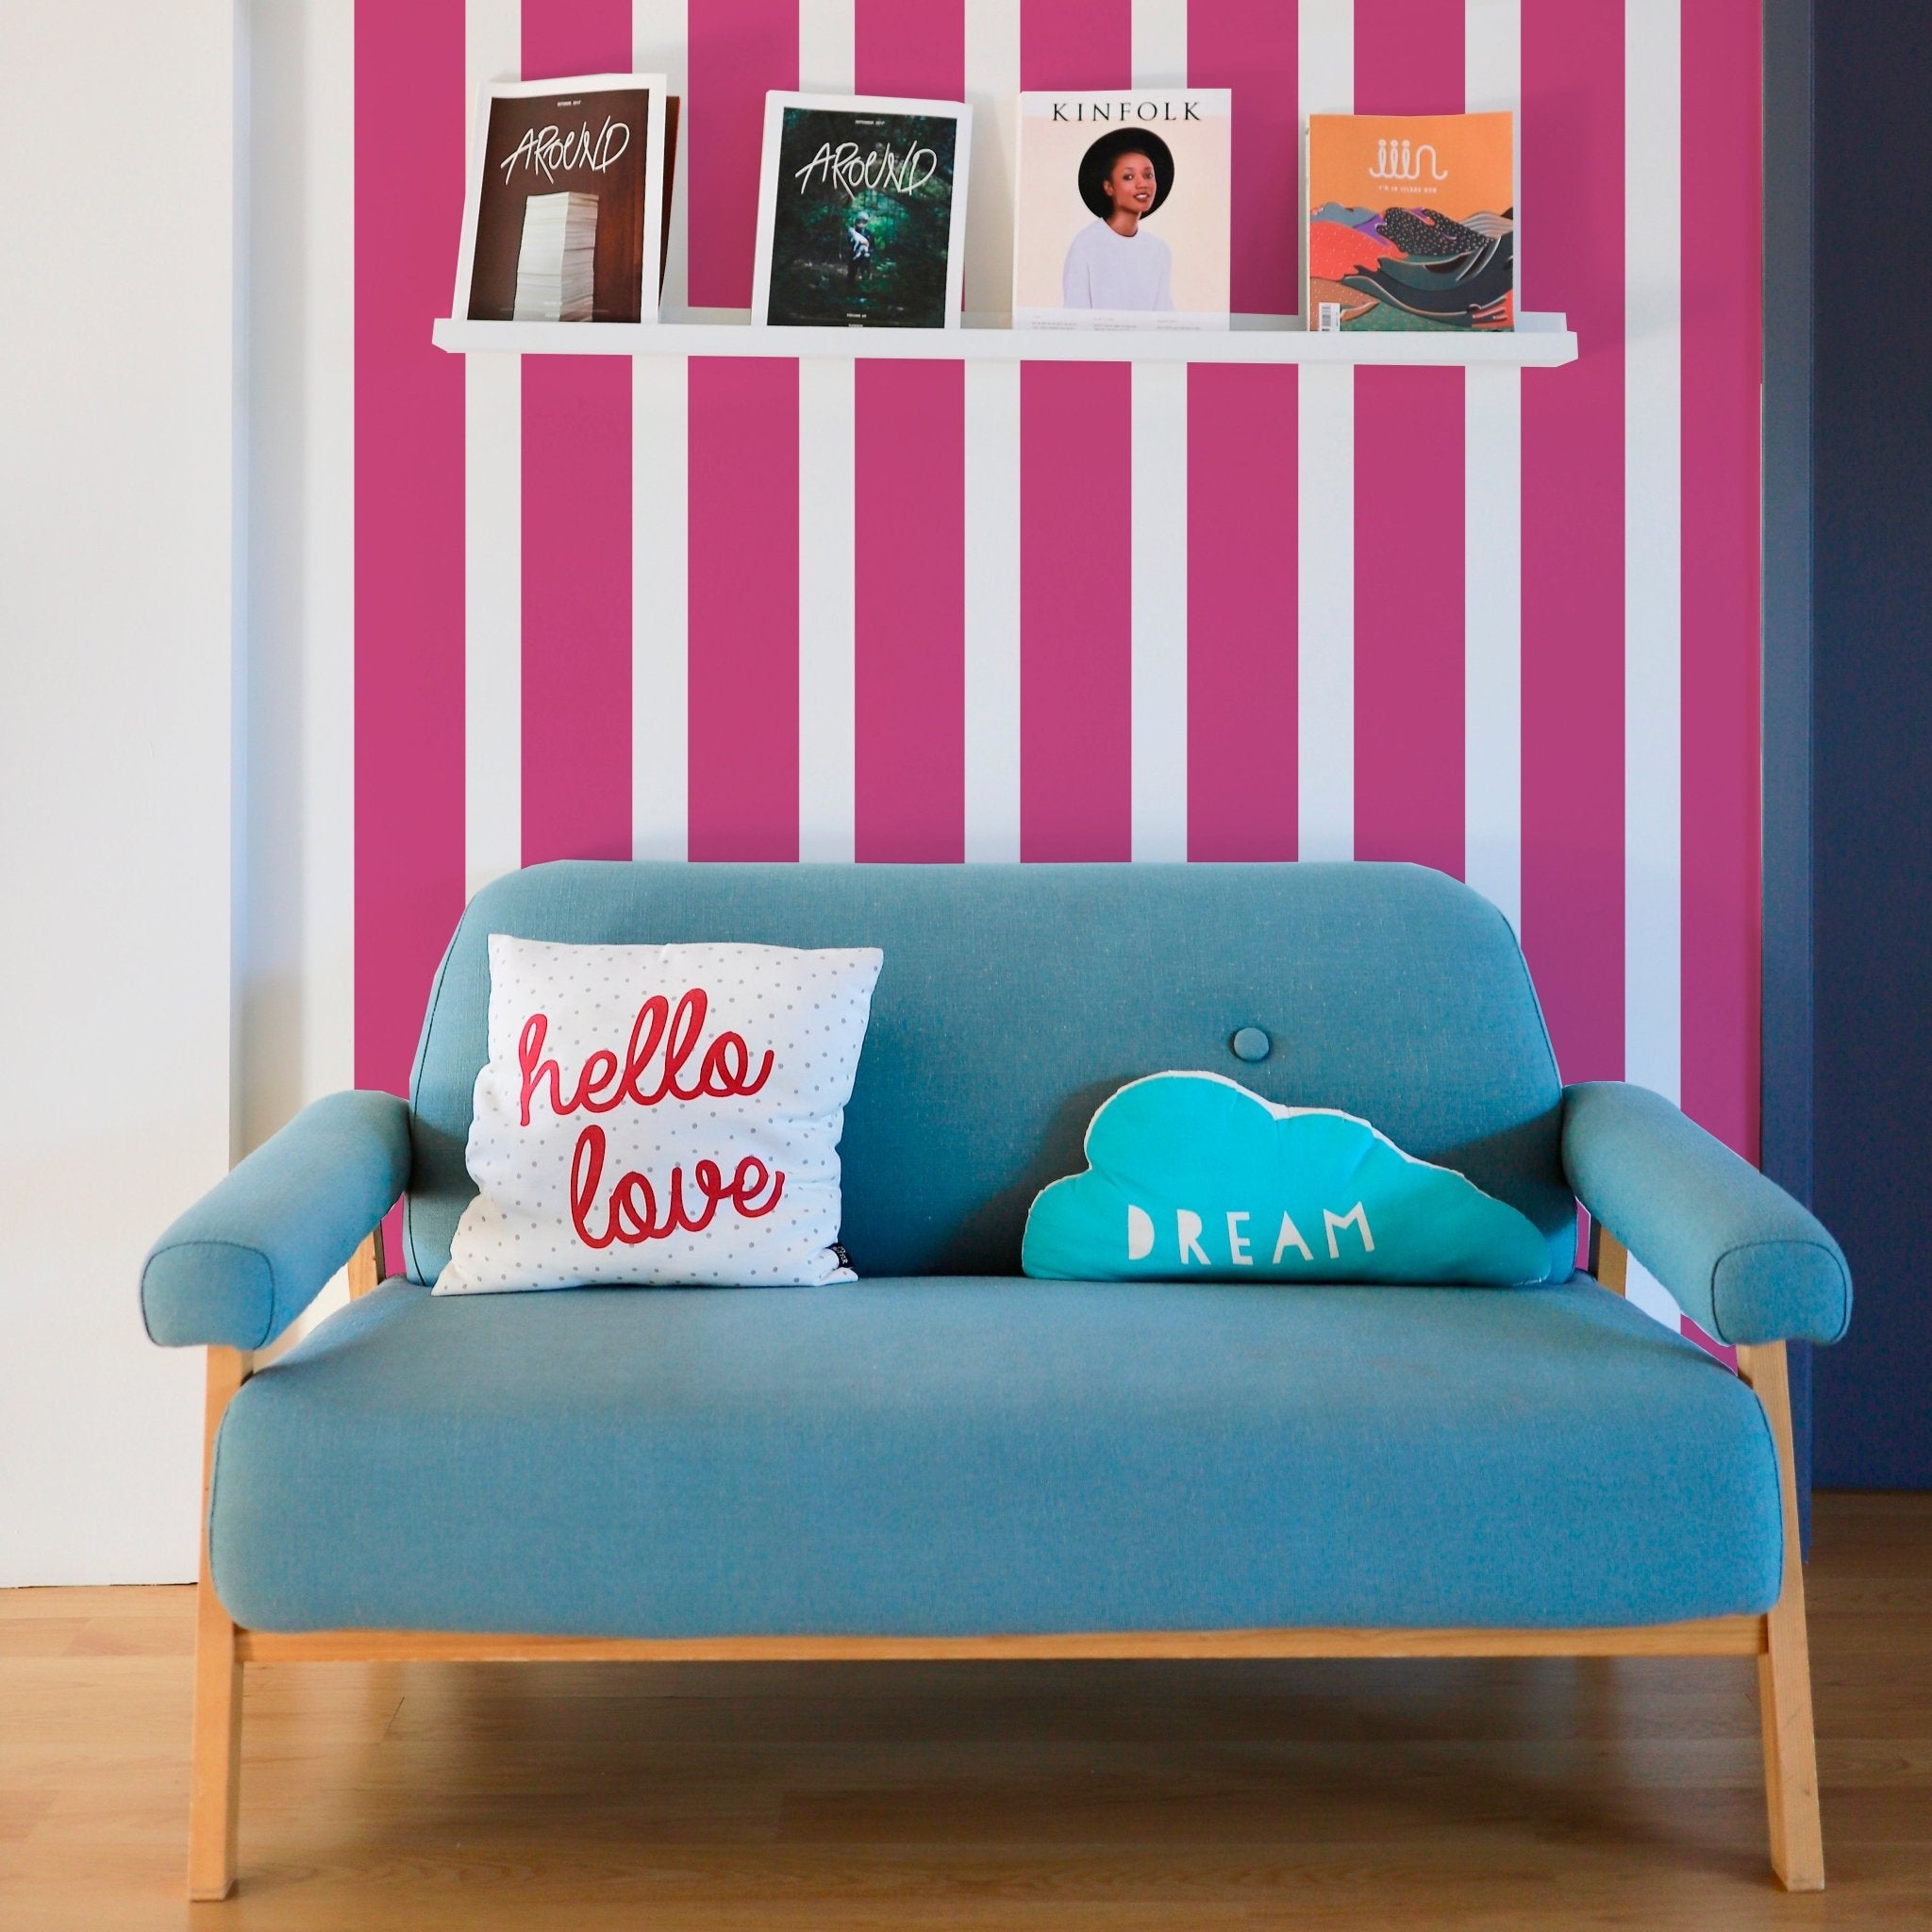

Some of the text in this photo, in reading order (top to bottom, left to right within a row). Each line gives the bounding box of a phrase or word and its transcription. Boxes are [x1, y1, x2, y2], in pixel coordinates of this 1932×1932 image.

[1053, 102, 1202, 122] KINFOLK
[501, 115, 629, 185] AROUND
[795, 141, 938, 199] AROUND
[519, 988, 774, 1126] hello
[571, 1124, 785, 1249] love
[1127, 1201, 1375, 1265] DREAM
